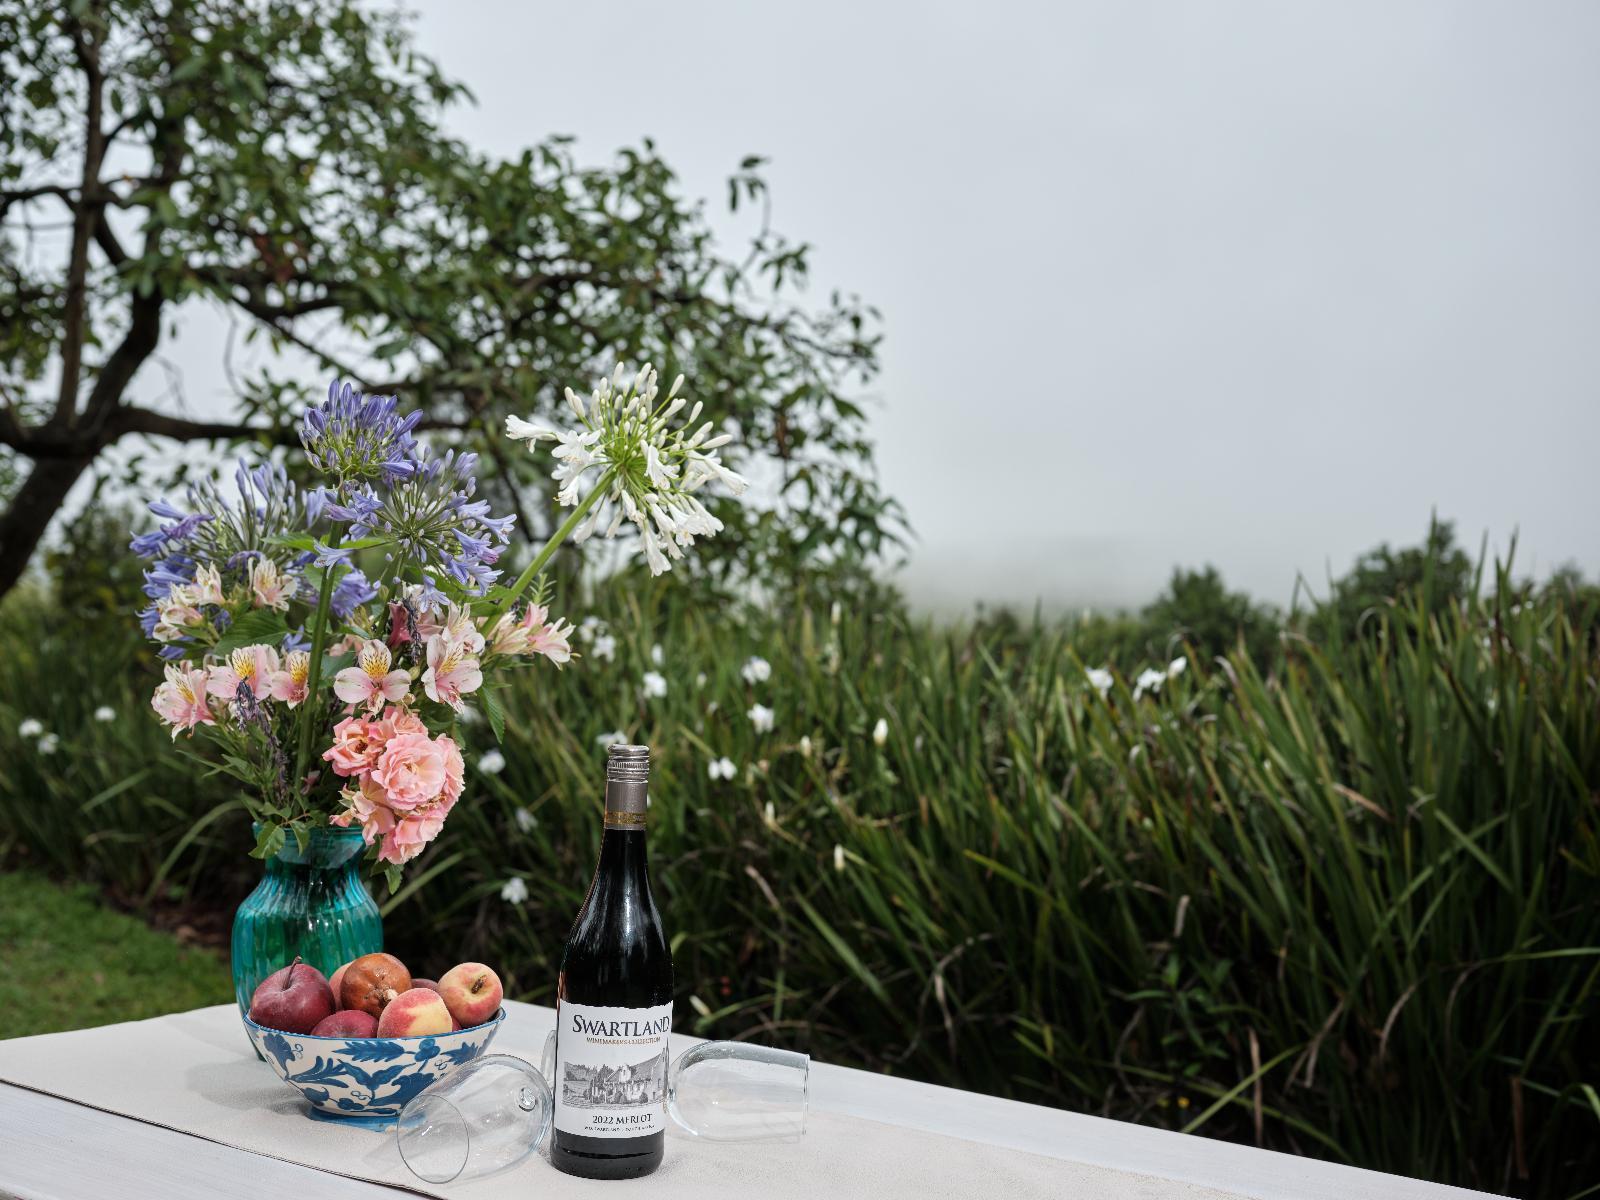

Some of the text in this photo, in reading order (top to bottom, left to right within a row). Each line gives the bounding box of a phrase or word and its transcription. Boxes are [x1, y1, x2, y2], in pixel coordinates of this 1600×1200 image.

[572, 1014, 670, 1037] SWARTLAND
[592, 1113, 653, 1125] 2022 MERLOT
